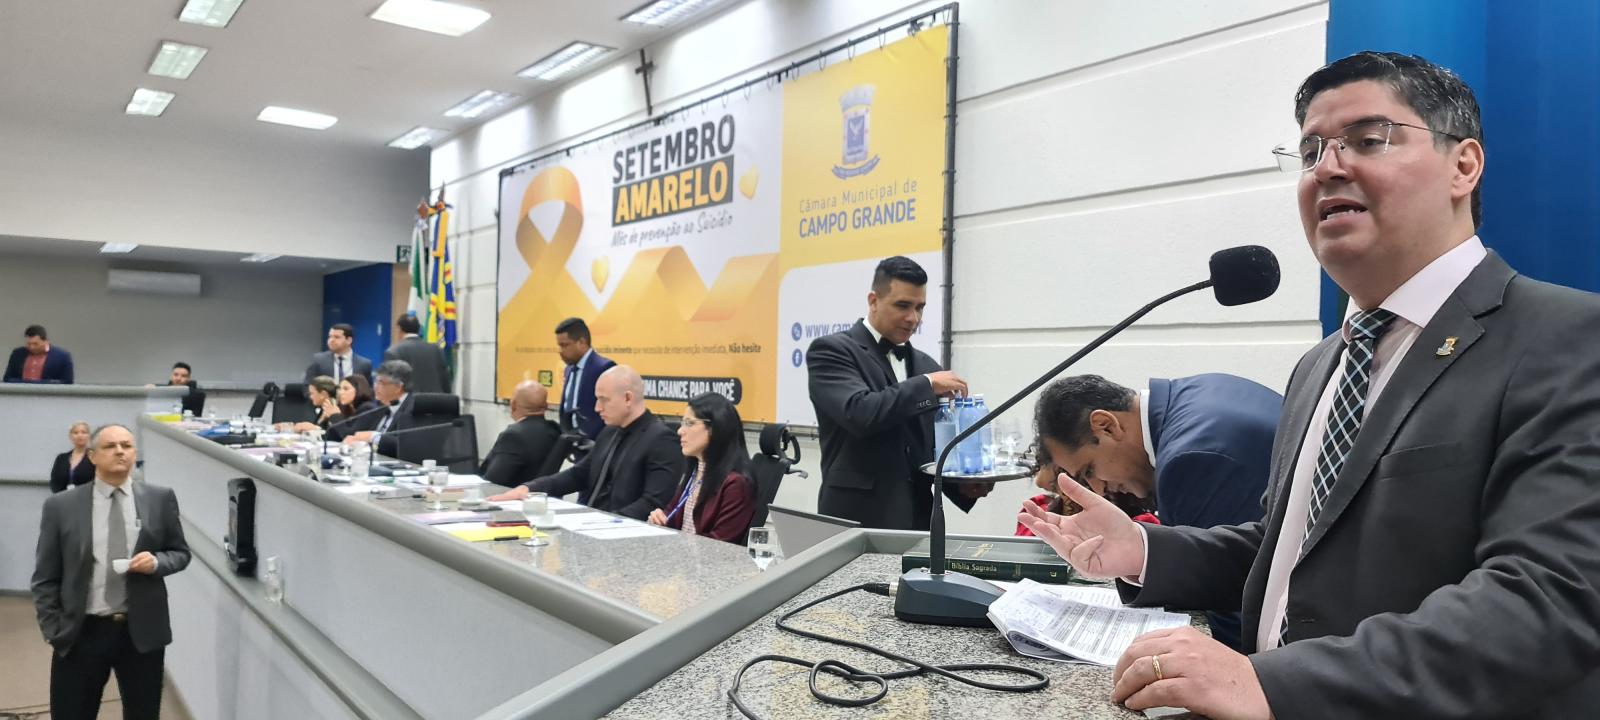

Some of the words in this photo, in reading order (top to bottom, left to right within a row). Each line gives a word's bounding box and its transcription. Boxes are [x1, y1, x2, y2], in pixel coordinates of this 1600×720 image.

[613, 114, 735, 184] SETEMBRO
[615, 160, 728, 223] AMARELO
[800, 196, 837, 213] Câmara
[842, 181, 897, 205] Municipal
[903, 178, 918, 194] de
[799, 210, 848, 238] CAMPO
[852, 198, 917, 230] GRANDE
[728, 343, 740, 353] Não
[741, 342, 761, 353] hesite
[658, 380, 689, 399] CHANCE
[689, 381, 710, 399] PARA
[712, 378, 735, 401] VOCÊ
